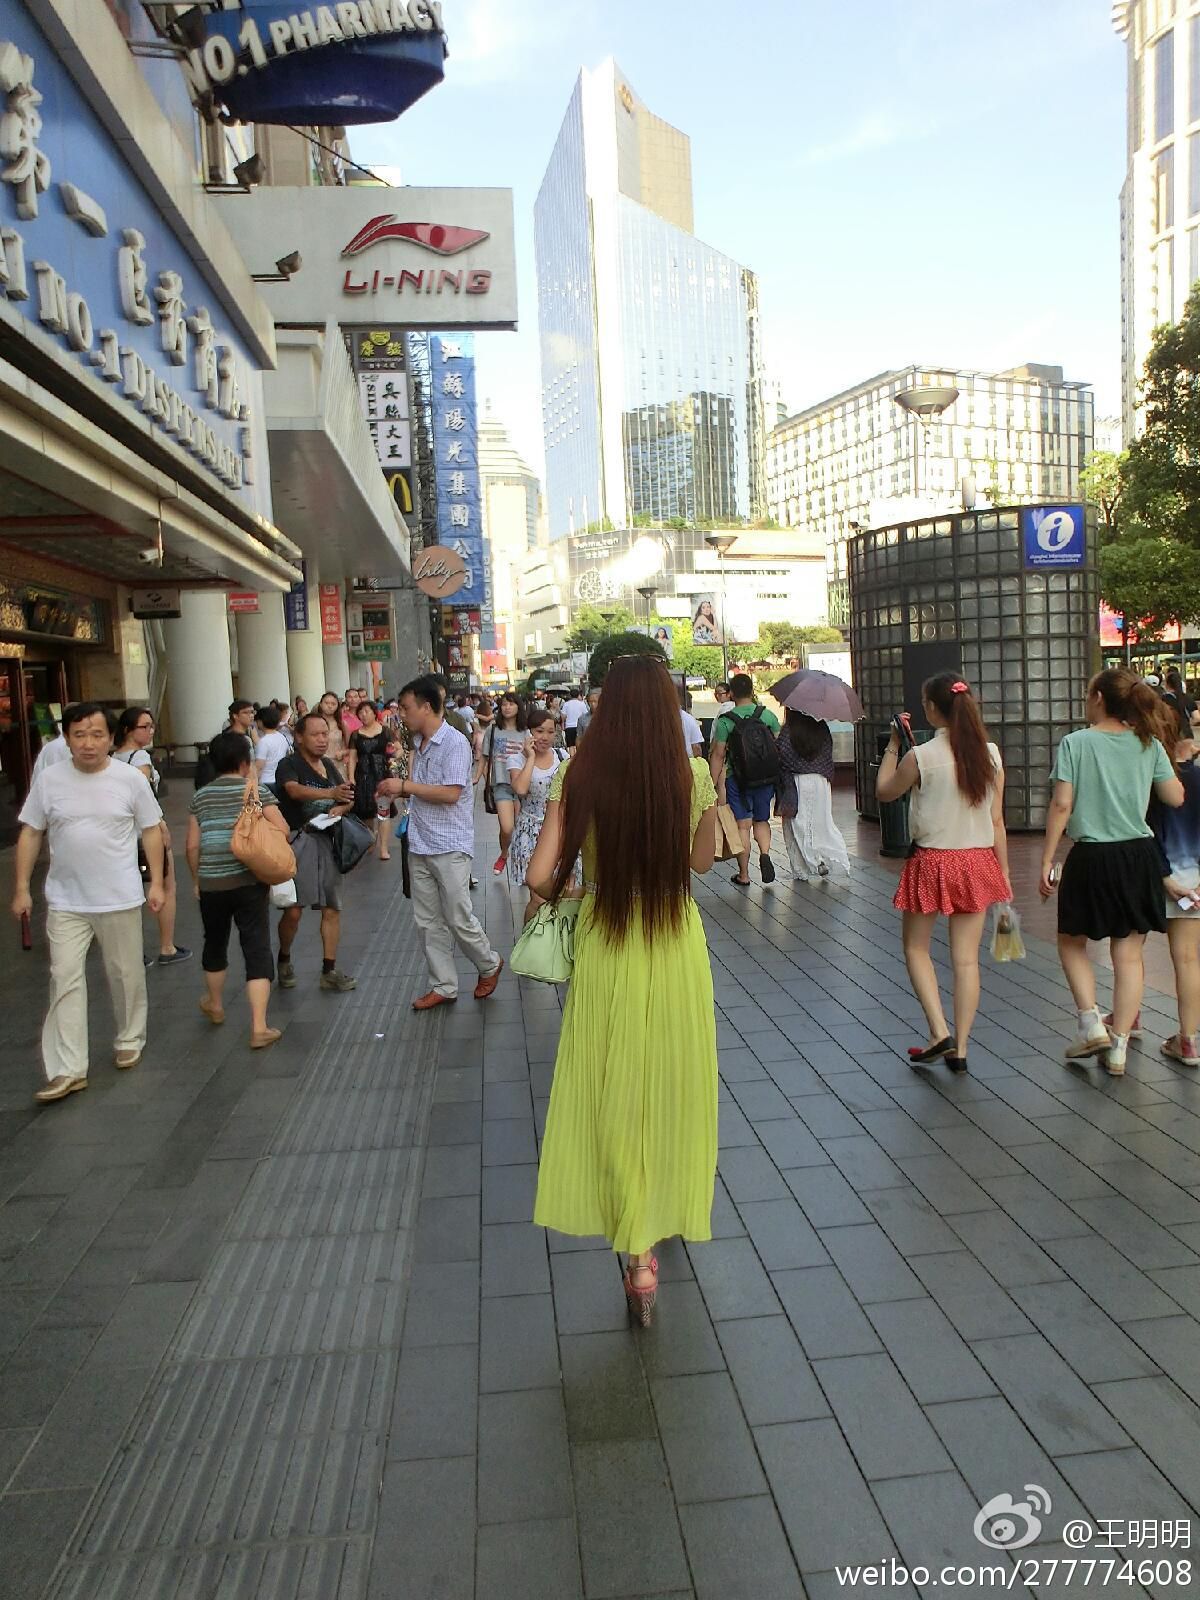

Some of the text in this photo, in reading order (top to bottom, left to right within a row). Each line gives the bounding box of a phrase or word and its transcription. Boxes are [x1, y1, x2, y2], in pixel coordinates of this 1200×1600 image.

[180, 0, 442, 103] NO.1 PHARMACY
[33, 260, 122, 382] NO.1
[343, 269, 492, 295] LI-NING
